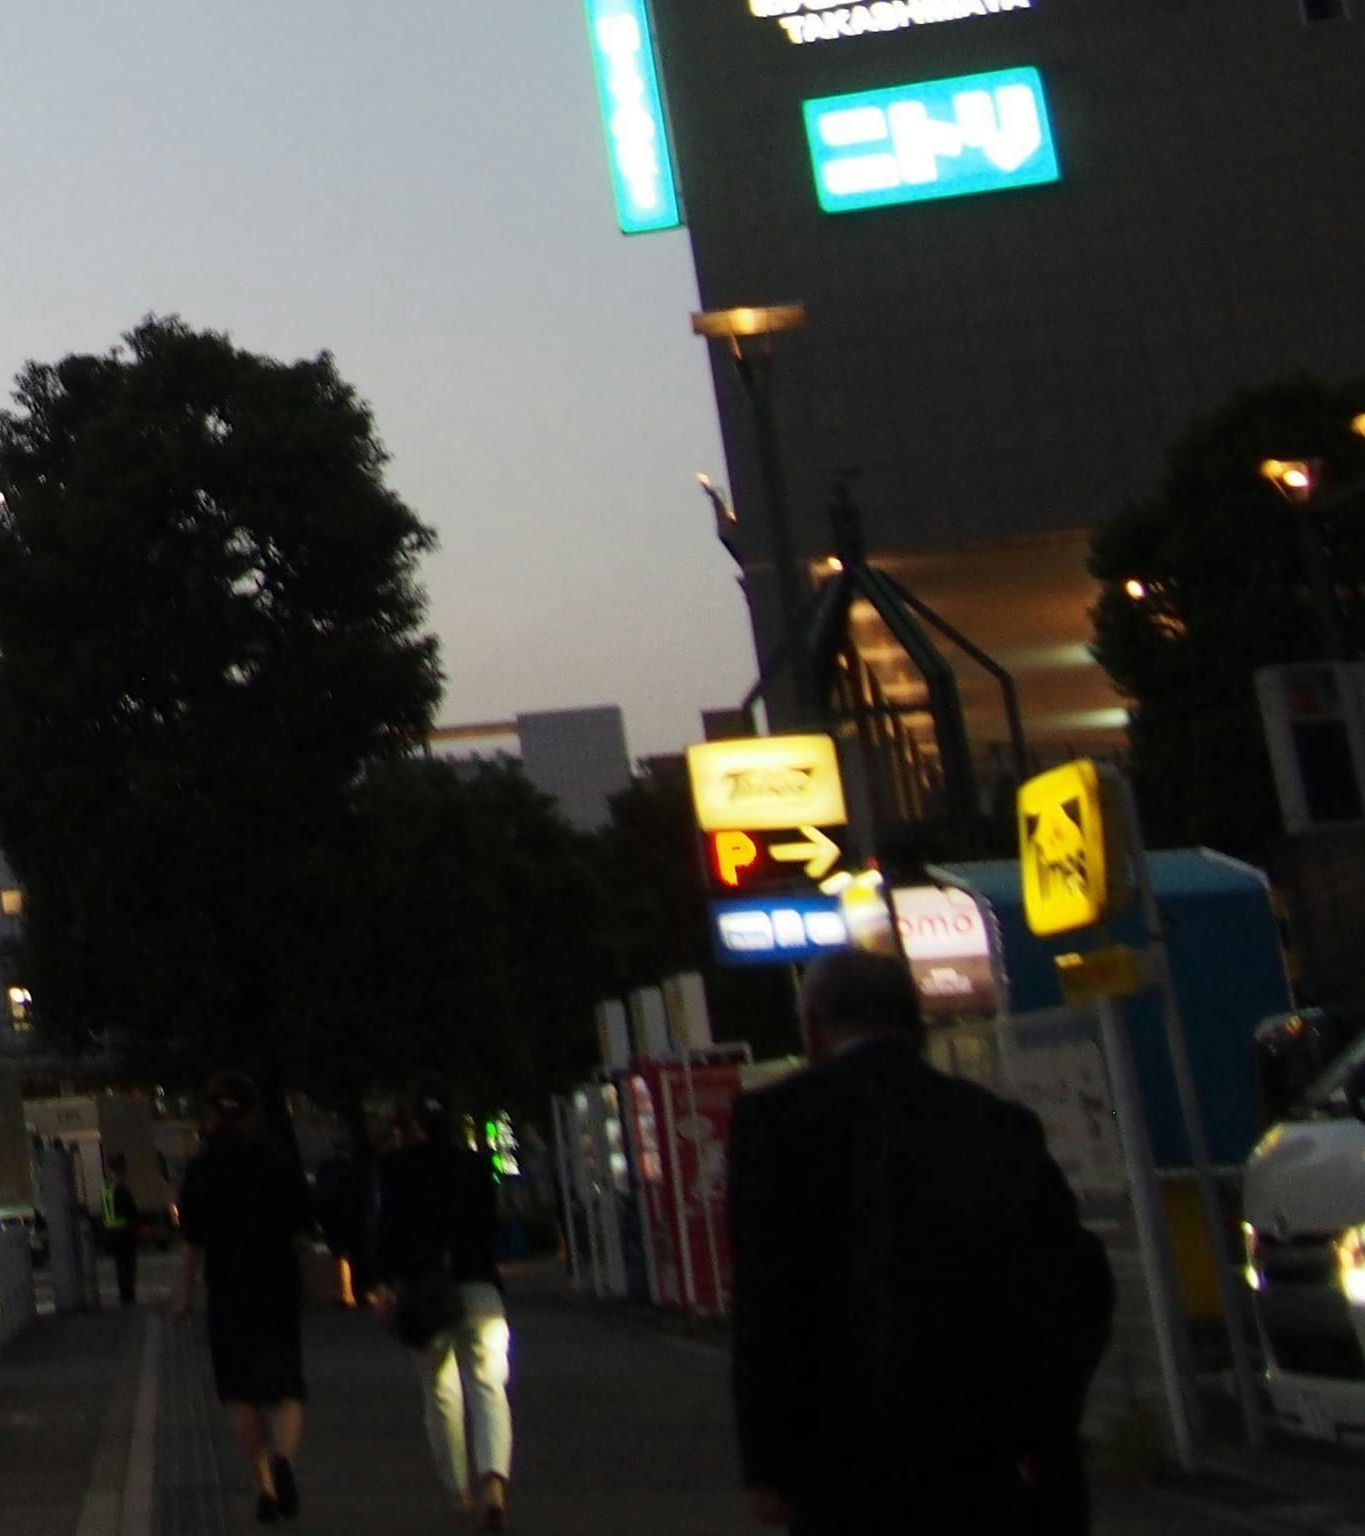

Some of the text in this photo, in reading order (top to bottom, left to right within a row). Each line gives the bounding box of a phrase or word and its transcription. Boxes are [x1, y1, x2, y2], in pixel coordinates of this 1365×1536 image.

[819, 85, 1041, 195] ニトリ
[713, 830, 757, 885] P
